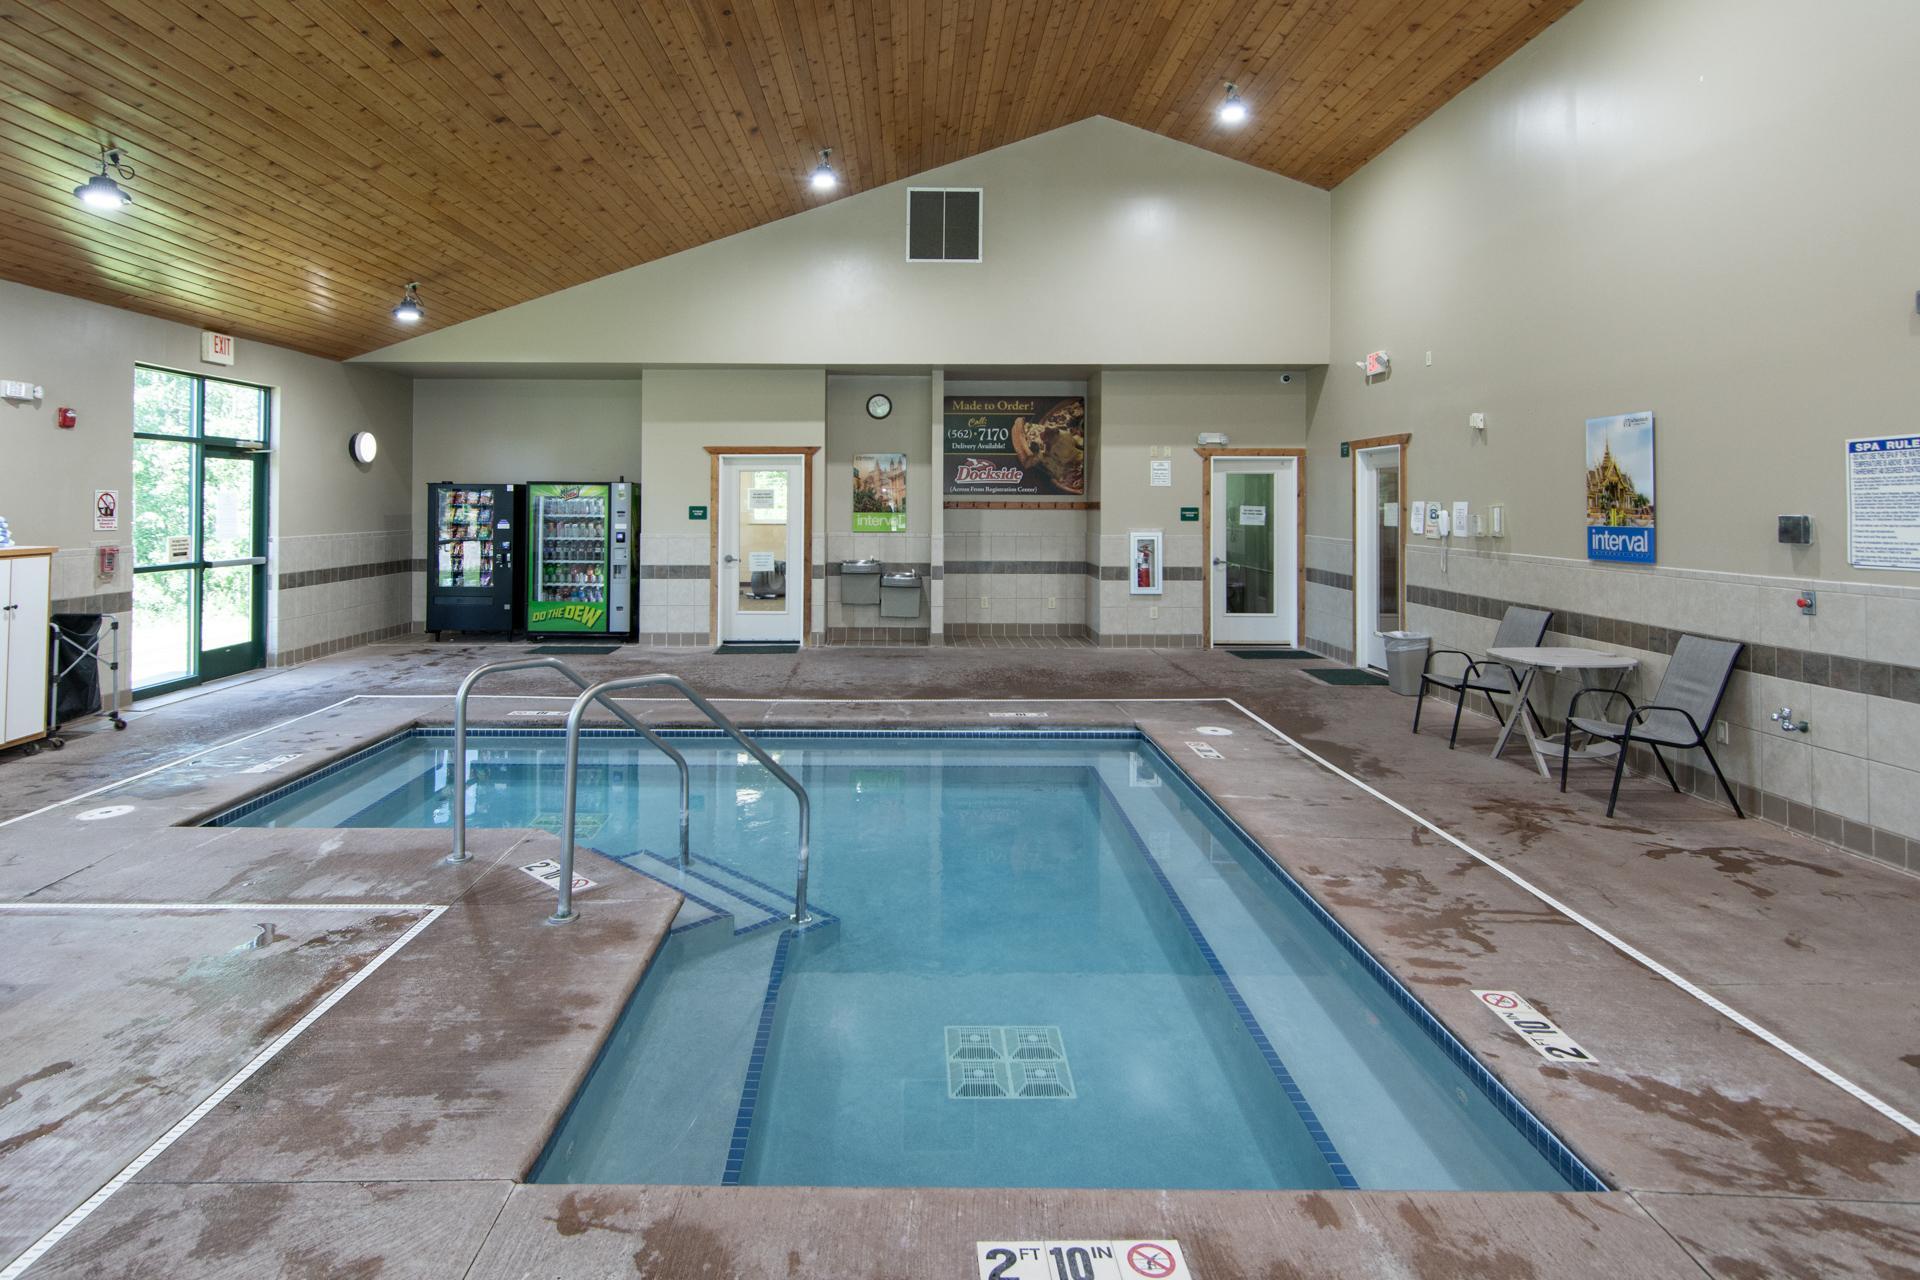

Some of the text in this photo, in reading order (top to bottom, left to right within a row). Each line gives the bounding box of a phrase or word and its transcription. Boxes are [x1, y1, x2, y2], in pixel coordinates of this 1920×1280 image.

[214, 335, 231, 357] EXIT
[952, 400, 1035, 411] Made to Order!
[978, 428, 1009, 441] 7170
[952, 442, 976, 451] Delivery
[1855, 438, 1920, 452] SPA RULE
[955, 465, 1024, 482] Dockside
[1592, 529, 1648, 553] interval
[532, 605, 602, 629] DO THE DEW
[525, 862, 551, 871] 2
[1514, 1020, 1558, 1035] 10
[1544, 1046, 1590, 1060] 2
[985, 1247, 1020, 1280] 2
[1049, 1246, 1095, 1280] 10
